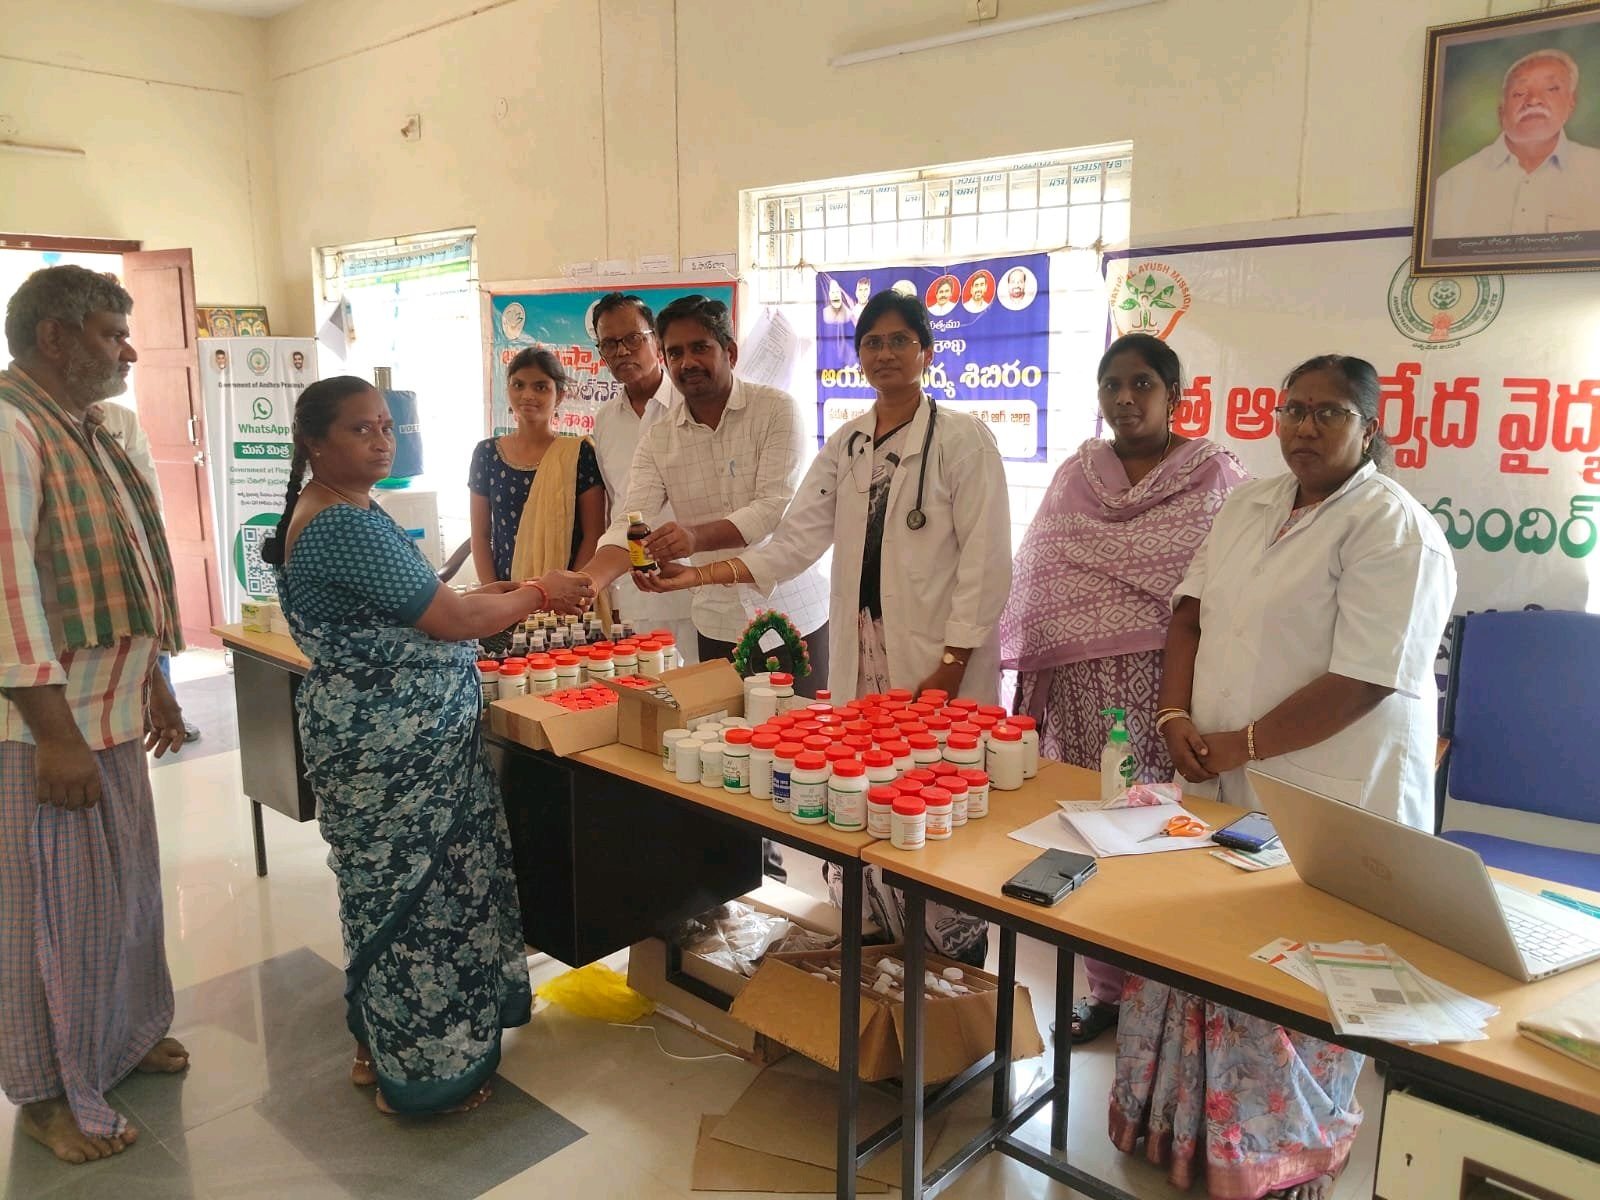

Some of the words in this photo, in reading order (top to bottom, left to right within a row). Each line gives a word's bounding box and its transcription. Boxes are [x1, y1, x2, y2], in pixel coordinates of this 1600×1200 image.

[1138, 261, 1170, 275] AYUSH
[1169, 270, 1192, 310] MISSION
[959, 360, 1042, 388] శిబిరం
[238, 423, 290, 436] WhatsApp
[242, 445, 264, 455] మన
[266, 444, 290, 459] మిత్ర
